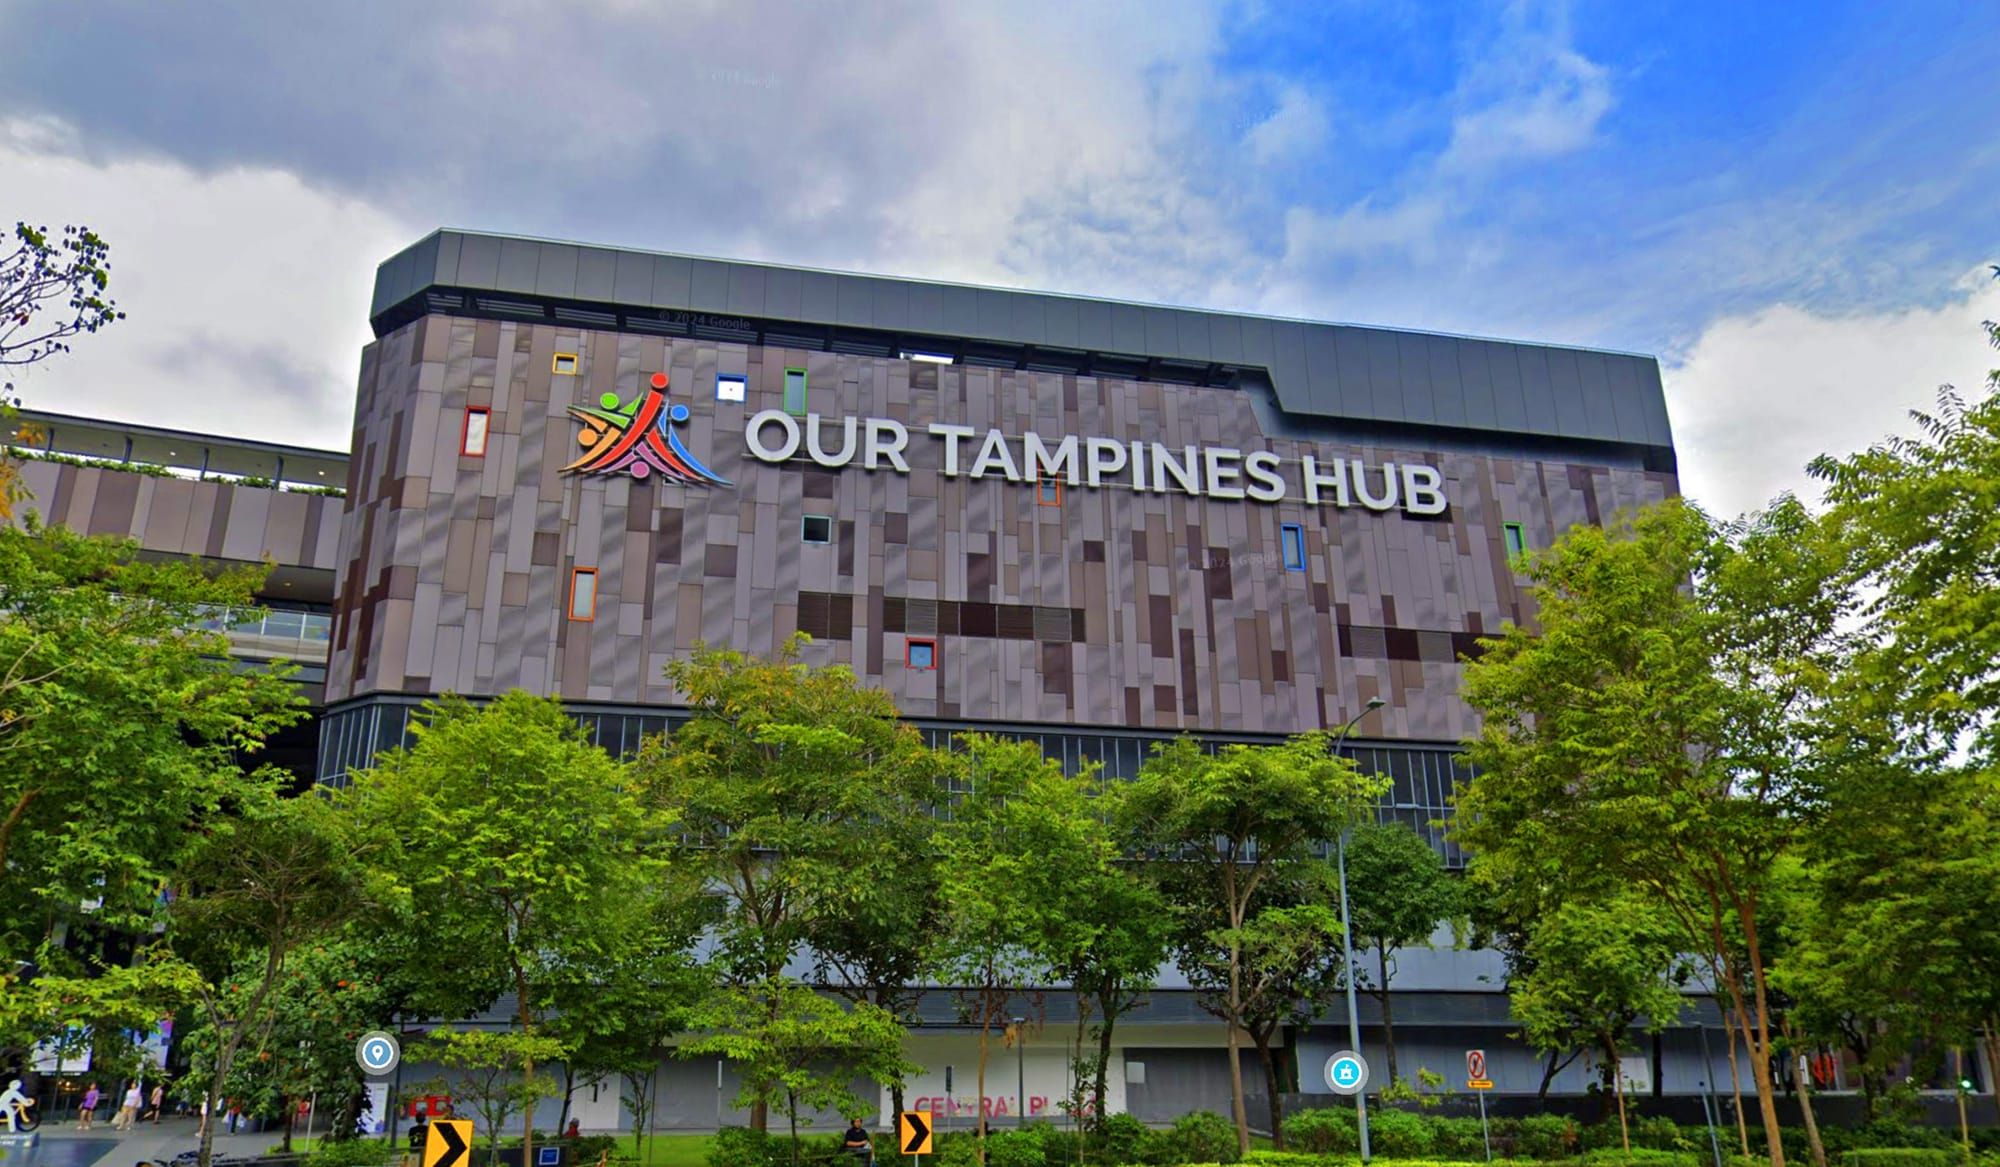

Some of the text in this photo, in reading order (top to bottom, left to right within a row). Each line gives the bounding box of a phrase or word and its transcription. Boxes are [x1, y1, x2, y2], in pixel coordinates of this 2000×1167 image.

[745, 409, 1448, 515] OUR TAMPINES HUB
